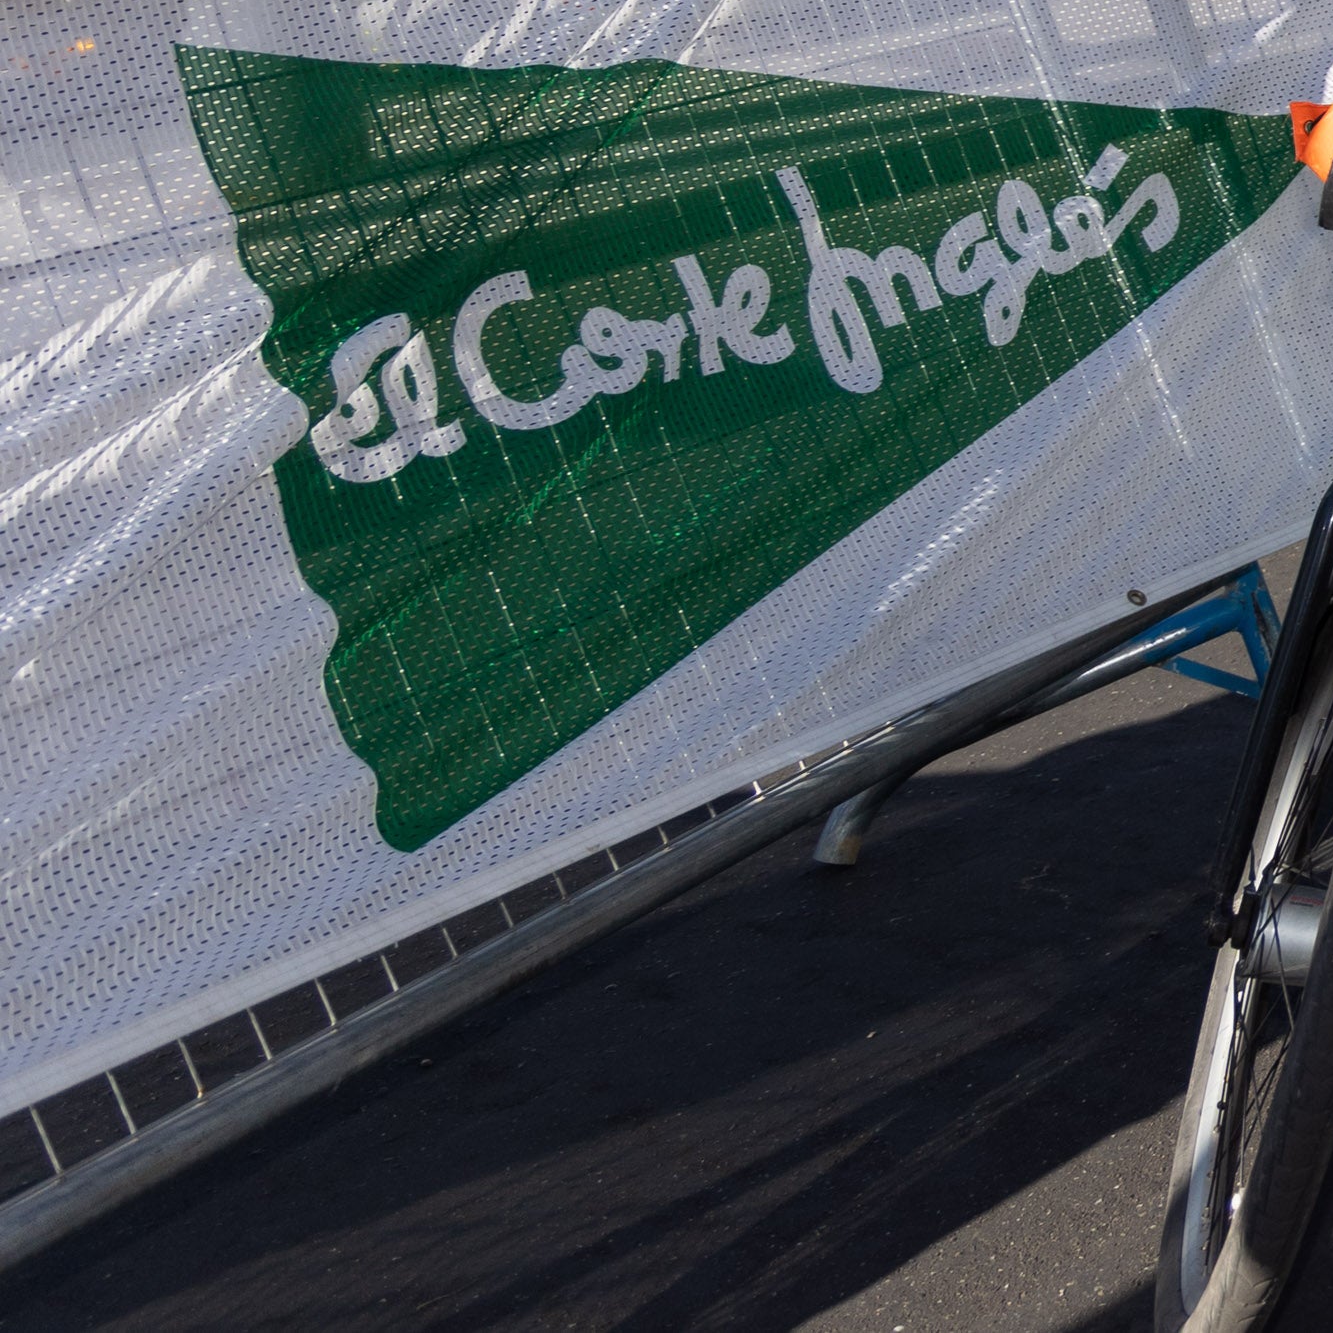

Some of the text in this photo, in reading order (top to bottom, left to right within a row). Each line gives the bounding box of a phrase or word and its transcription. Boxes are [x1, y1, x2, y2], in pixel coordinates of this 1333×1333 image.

[311, 144, 1180, 484] El Corte Inglés
